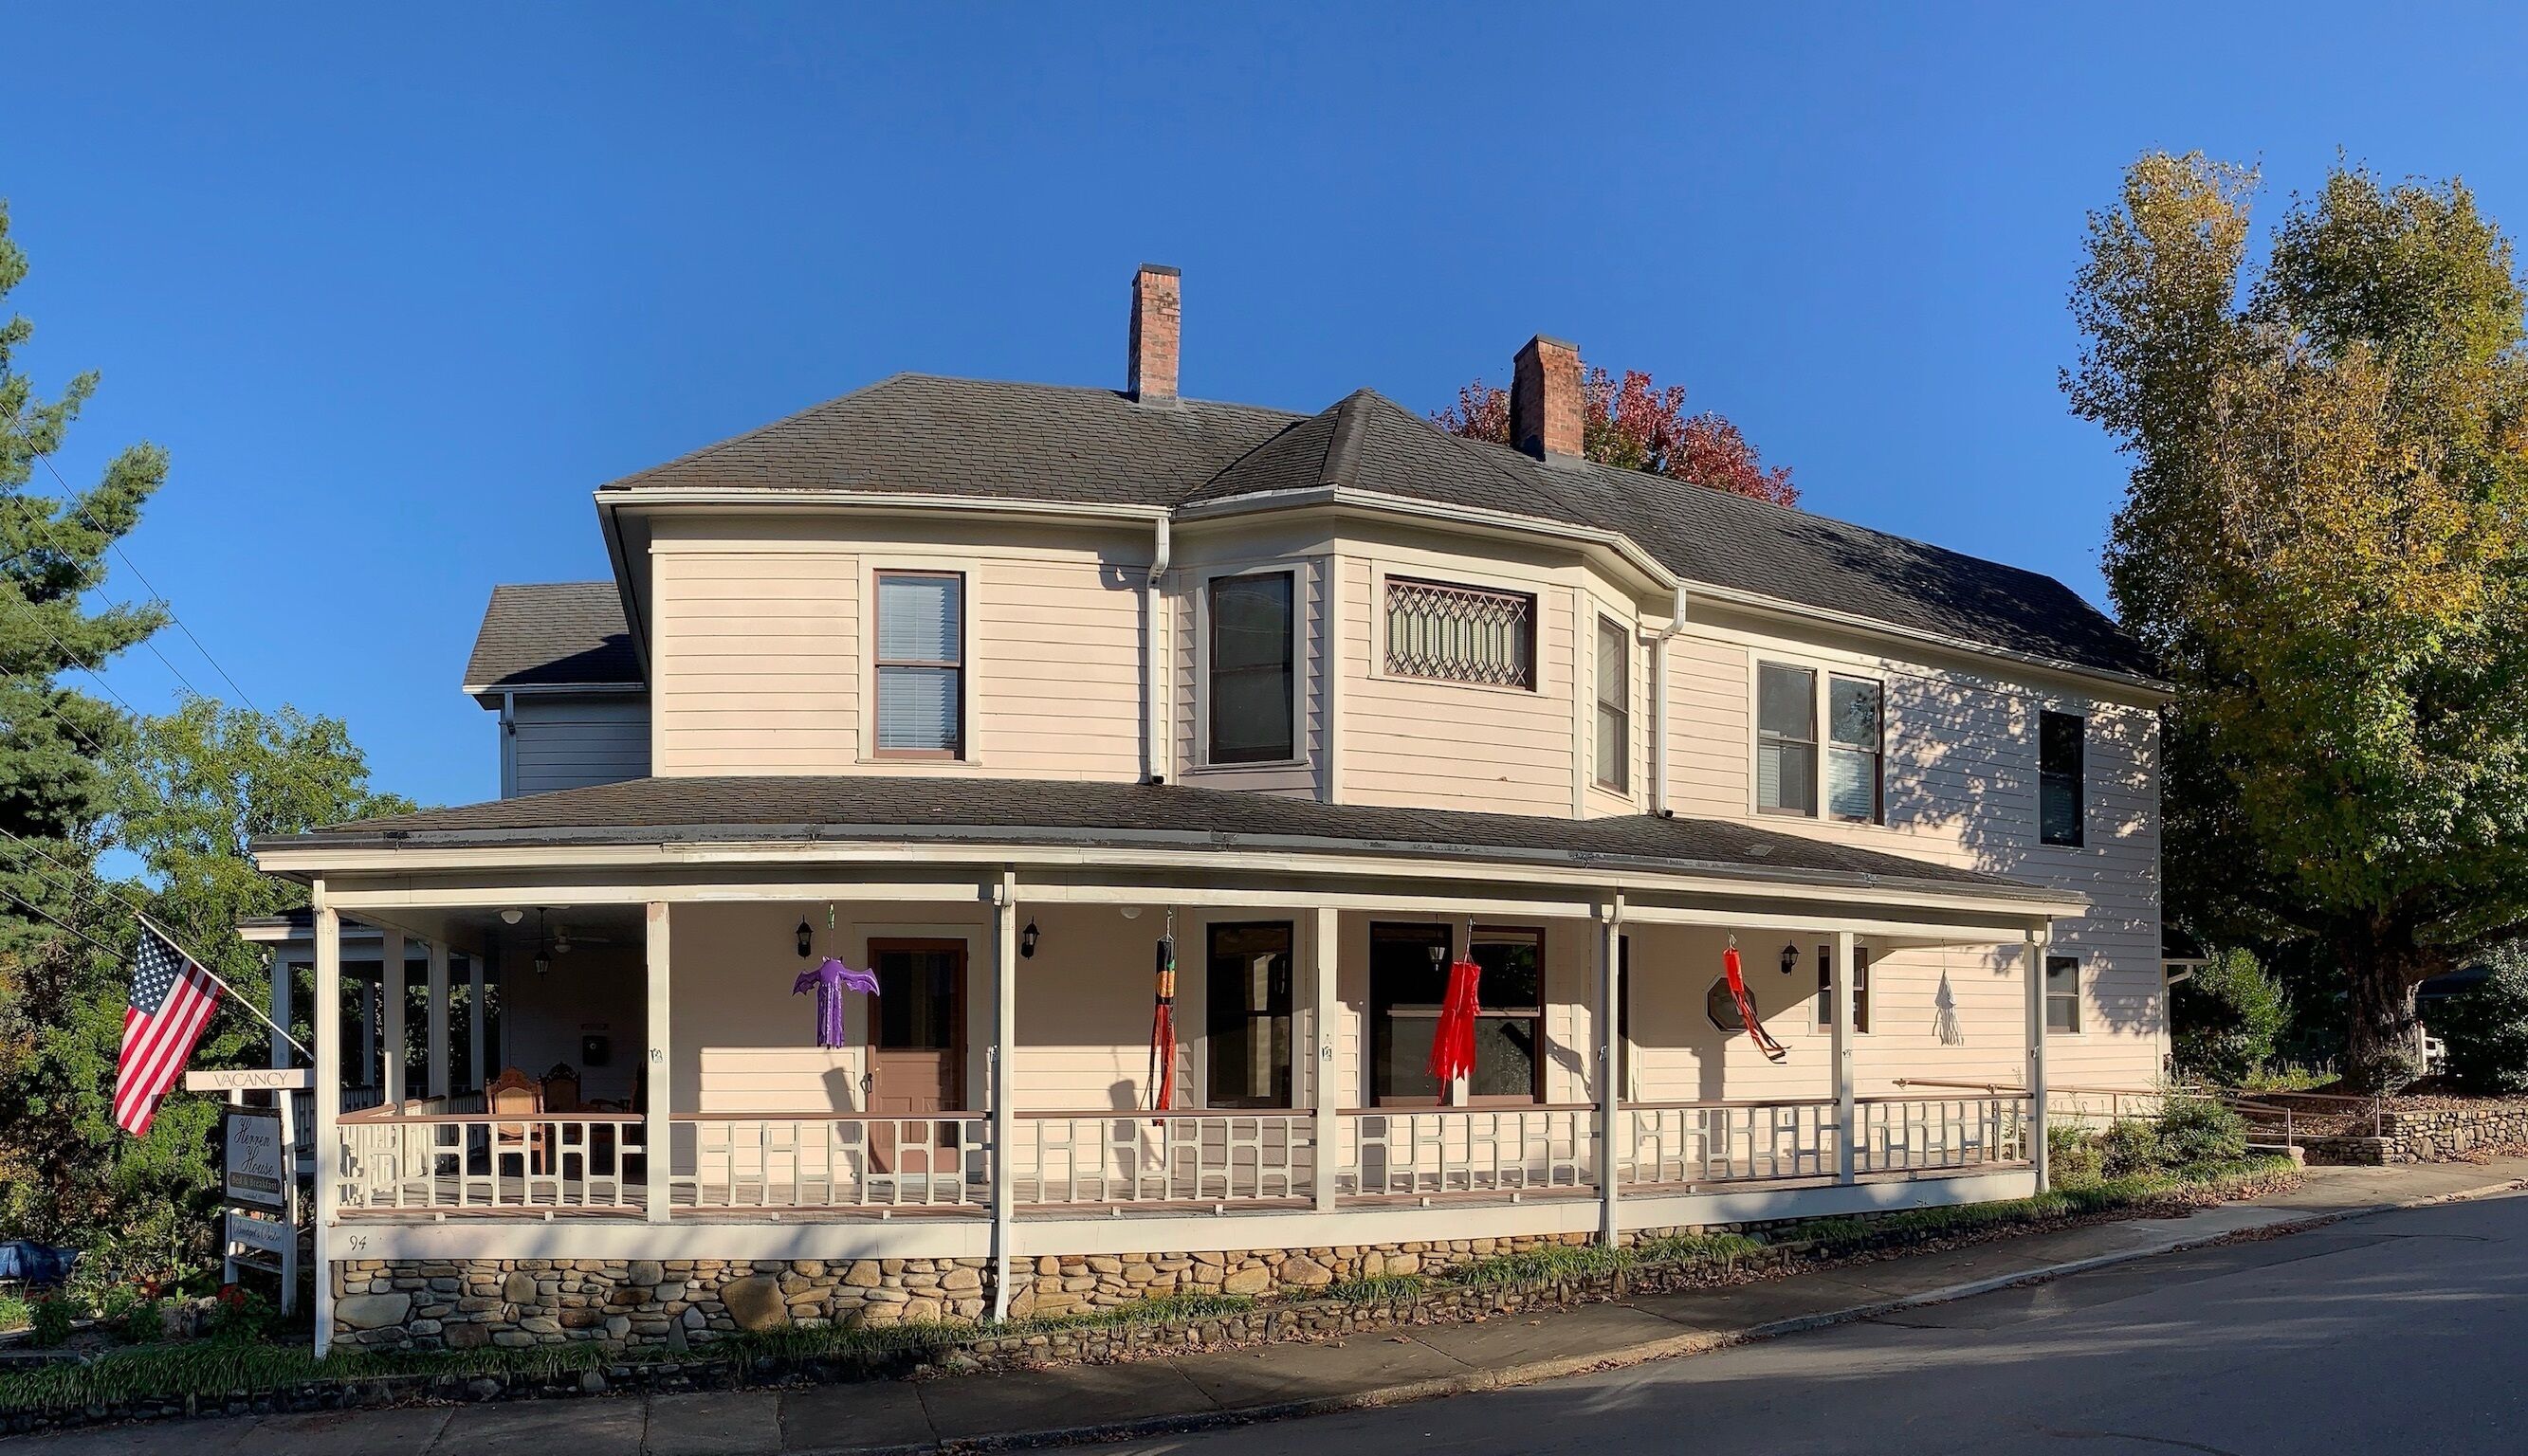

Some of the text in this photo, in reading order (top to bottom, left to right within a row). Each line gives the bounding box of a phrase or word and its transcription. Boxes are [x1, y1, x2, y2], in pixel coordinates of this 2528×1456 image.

[213, 1072, 288, 1087] VACANCY
[234, 1118, 271, 1147] Herren
[241, 1145, 274, 1175] House
[349, 1235, 367, 1251] 94
